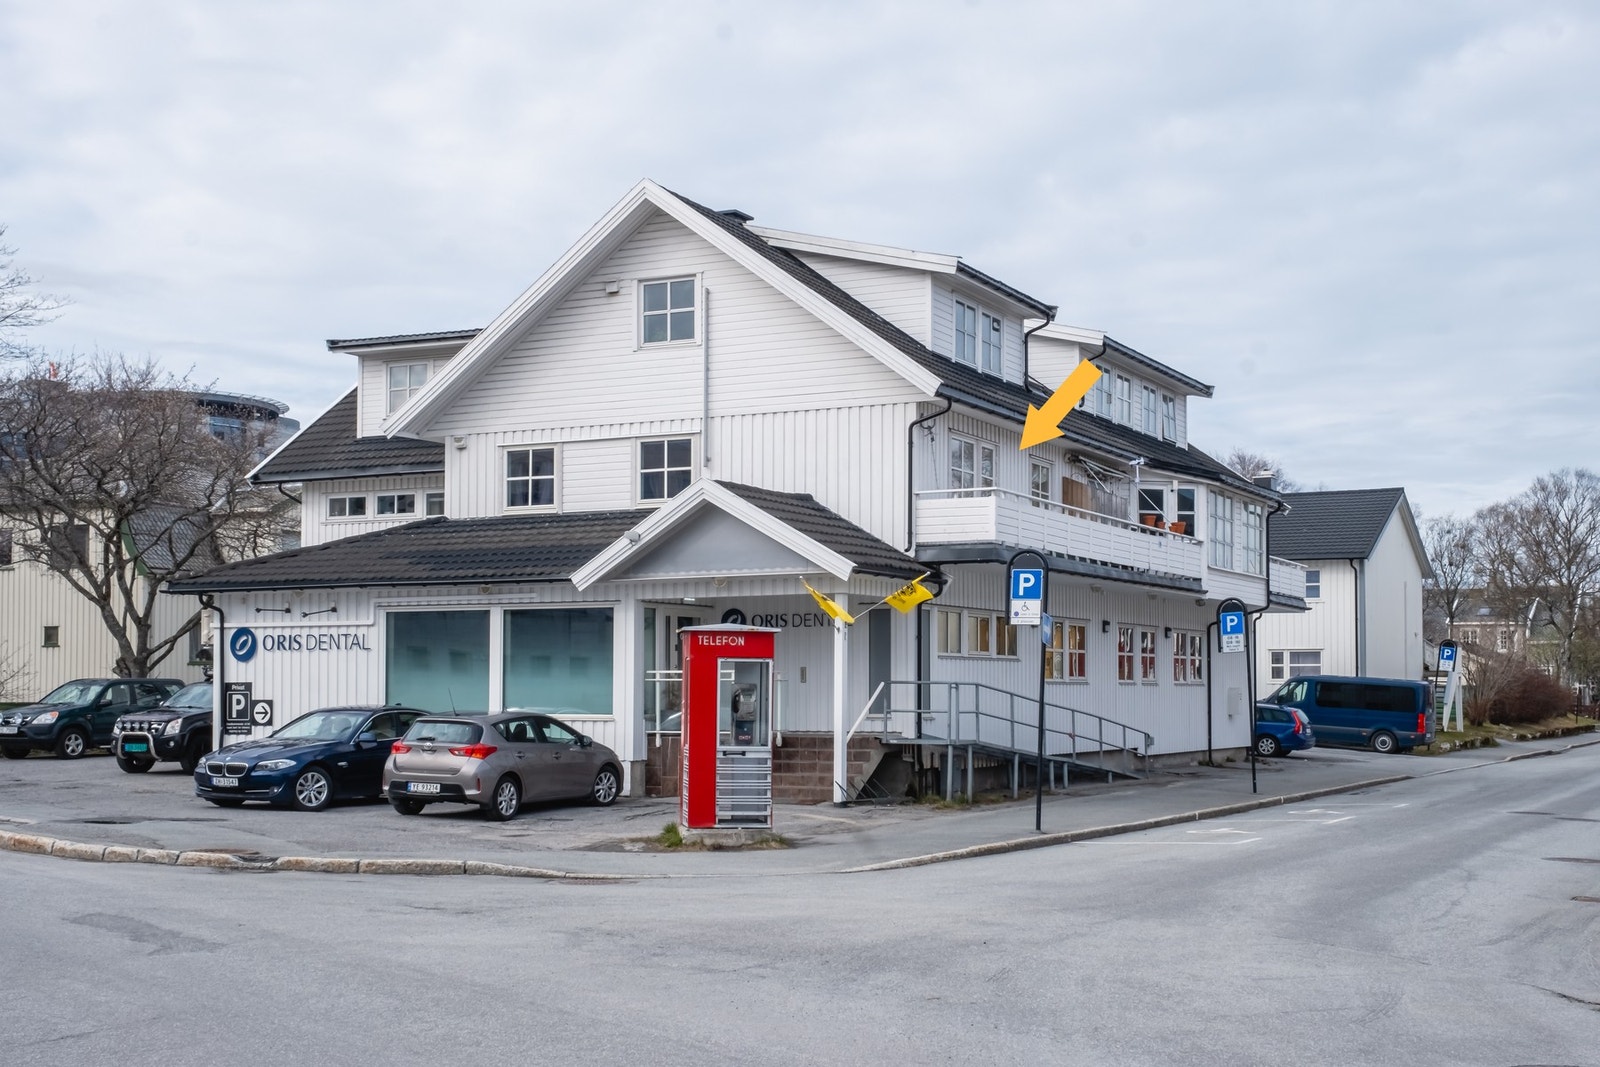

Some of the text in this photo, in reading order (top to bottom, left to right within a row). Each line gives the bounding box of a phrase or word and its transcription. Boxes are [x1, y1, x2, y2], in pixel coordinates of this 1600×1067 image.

[1019, 573, 1035, 596] P
[751, 614, 788, 628] ORIS
[1226, 615, 1238, 632] P
[262, 633, 371, 651] ORIS DENTAL
[698, 635, 745, 646] TELEFON
[1443, 649, 1451, 658] P
[232, 694, 246, 718] P
